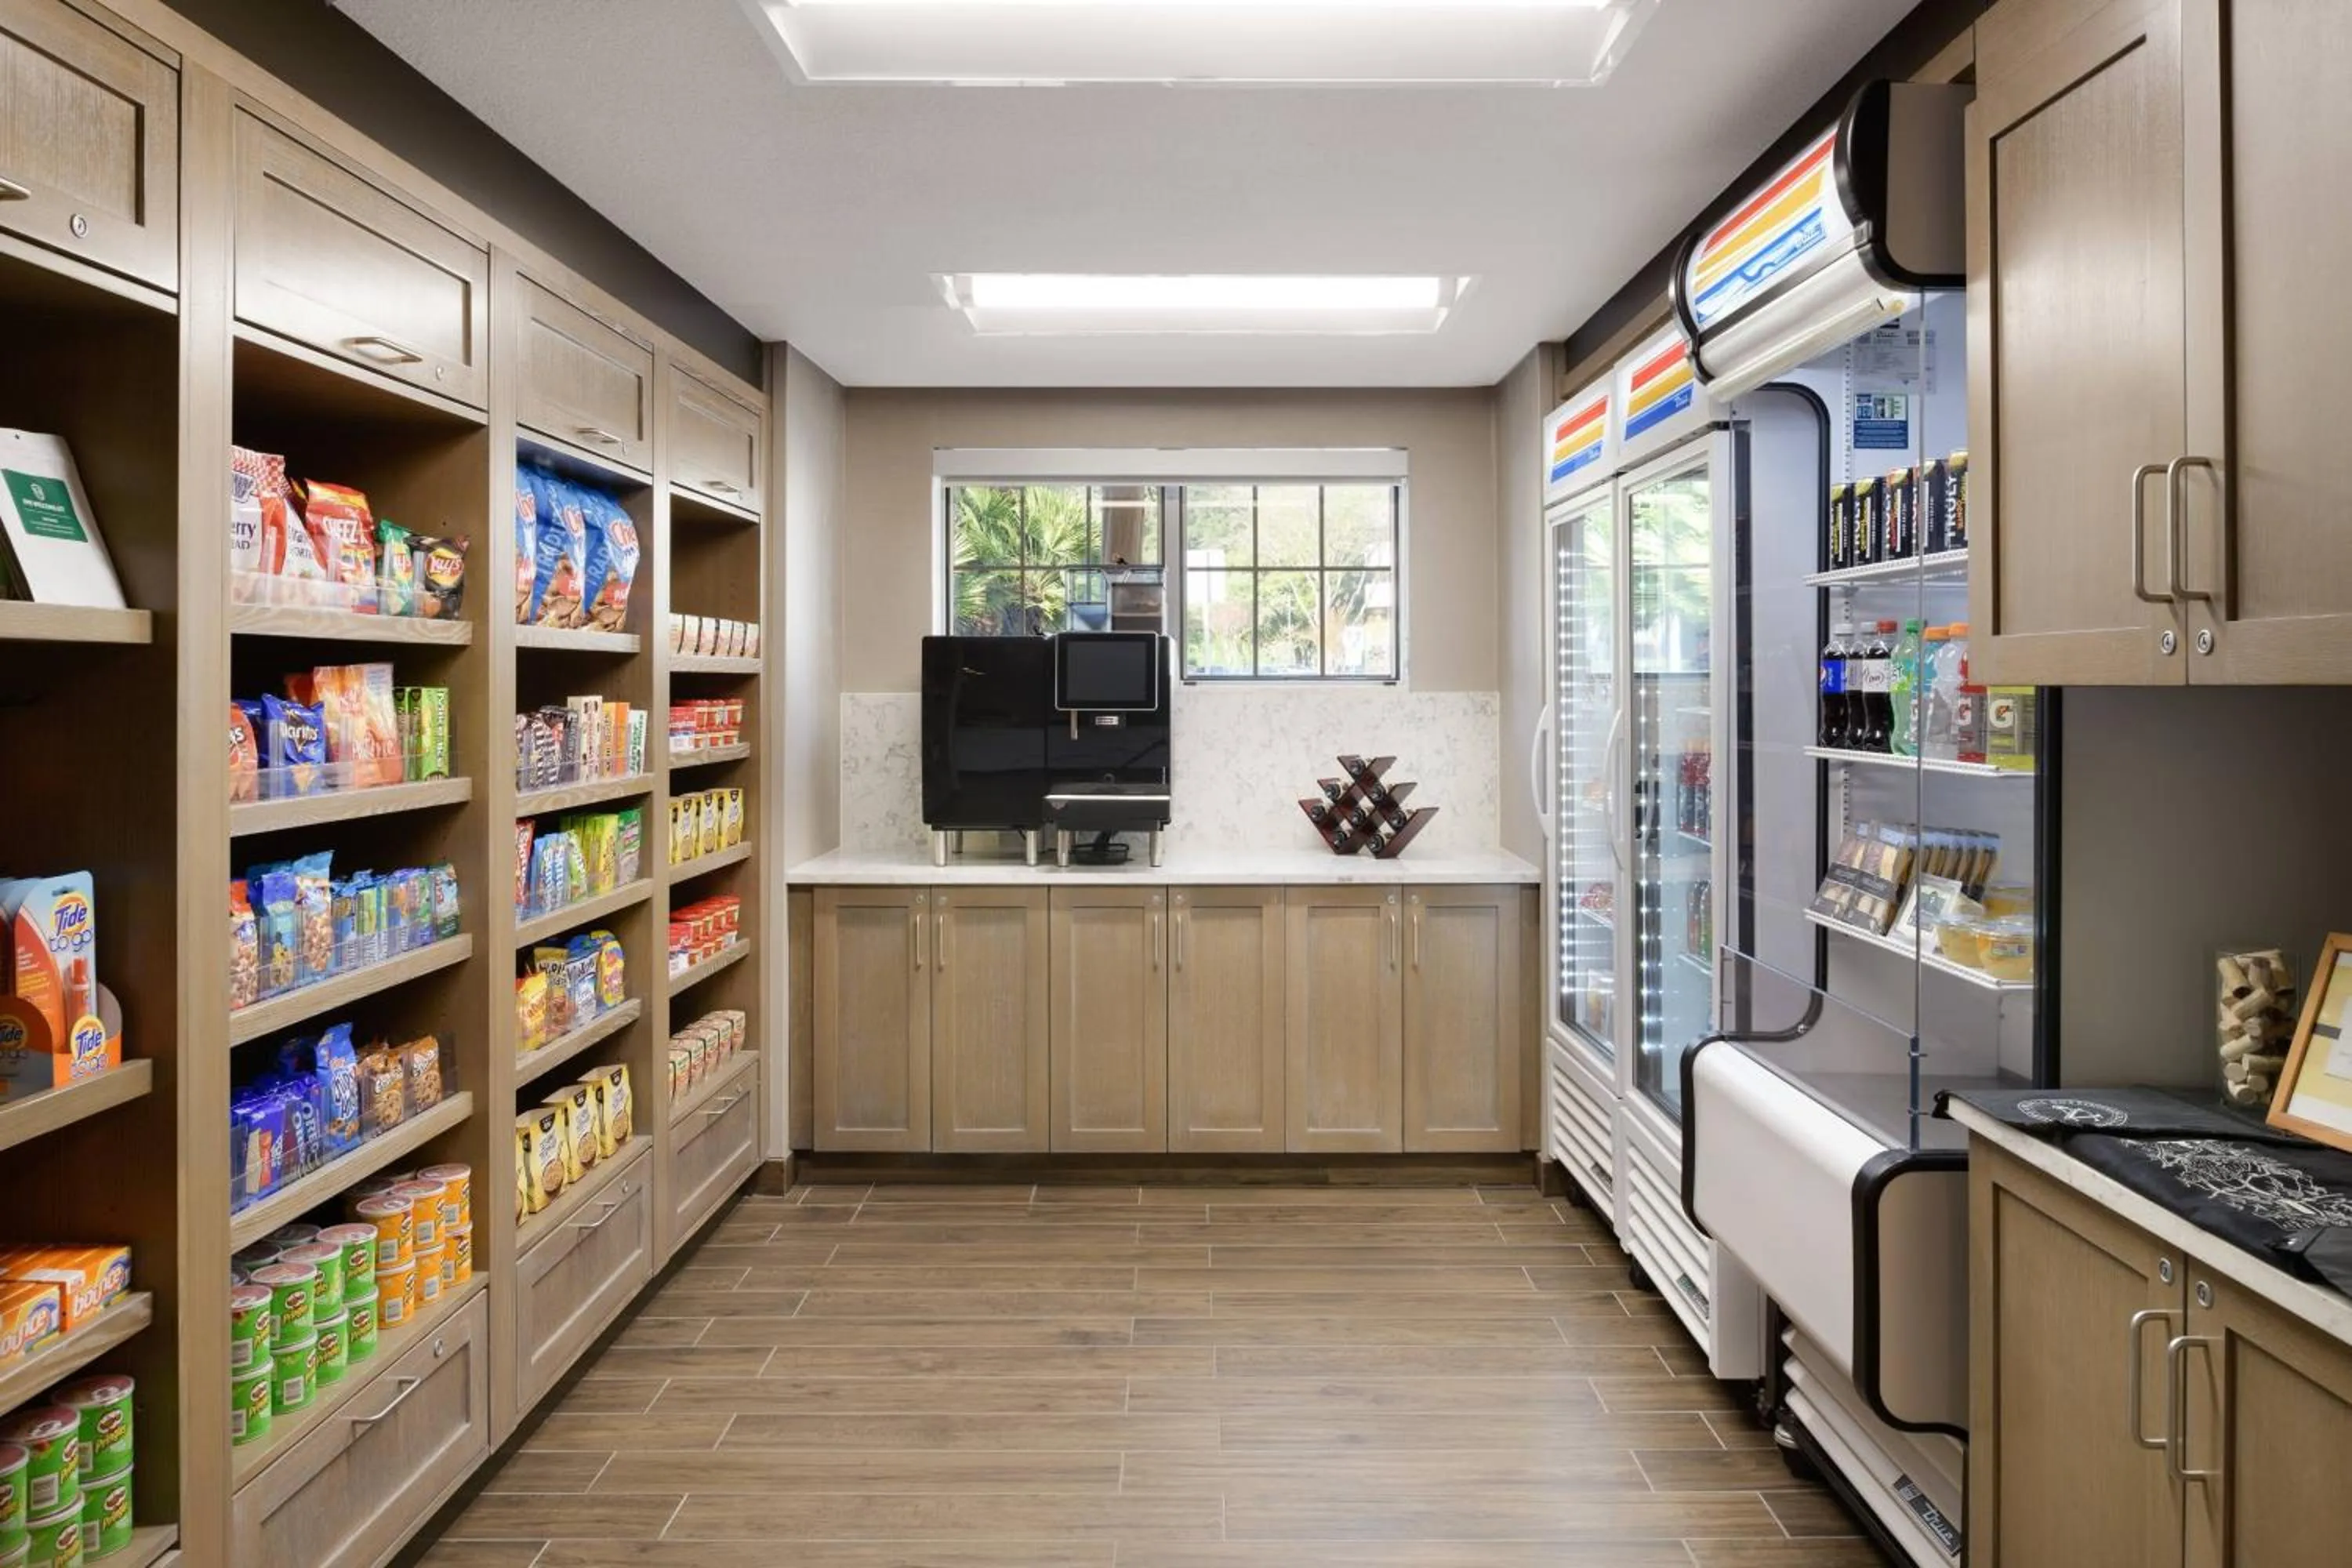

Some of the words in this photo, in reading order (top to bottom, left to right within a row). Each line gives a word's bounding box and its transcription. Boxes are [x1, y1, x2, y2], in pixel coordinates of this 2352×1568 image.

[1990, 699, 2014, 728] G
[279, 722, 318, 742] Doritos
[54, 903, 88, 935] Tide
[76, 1030, 103, 1058] Tide
[0, 1307, 50, 1358] ounce
